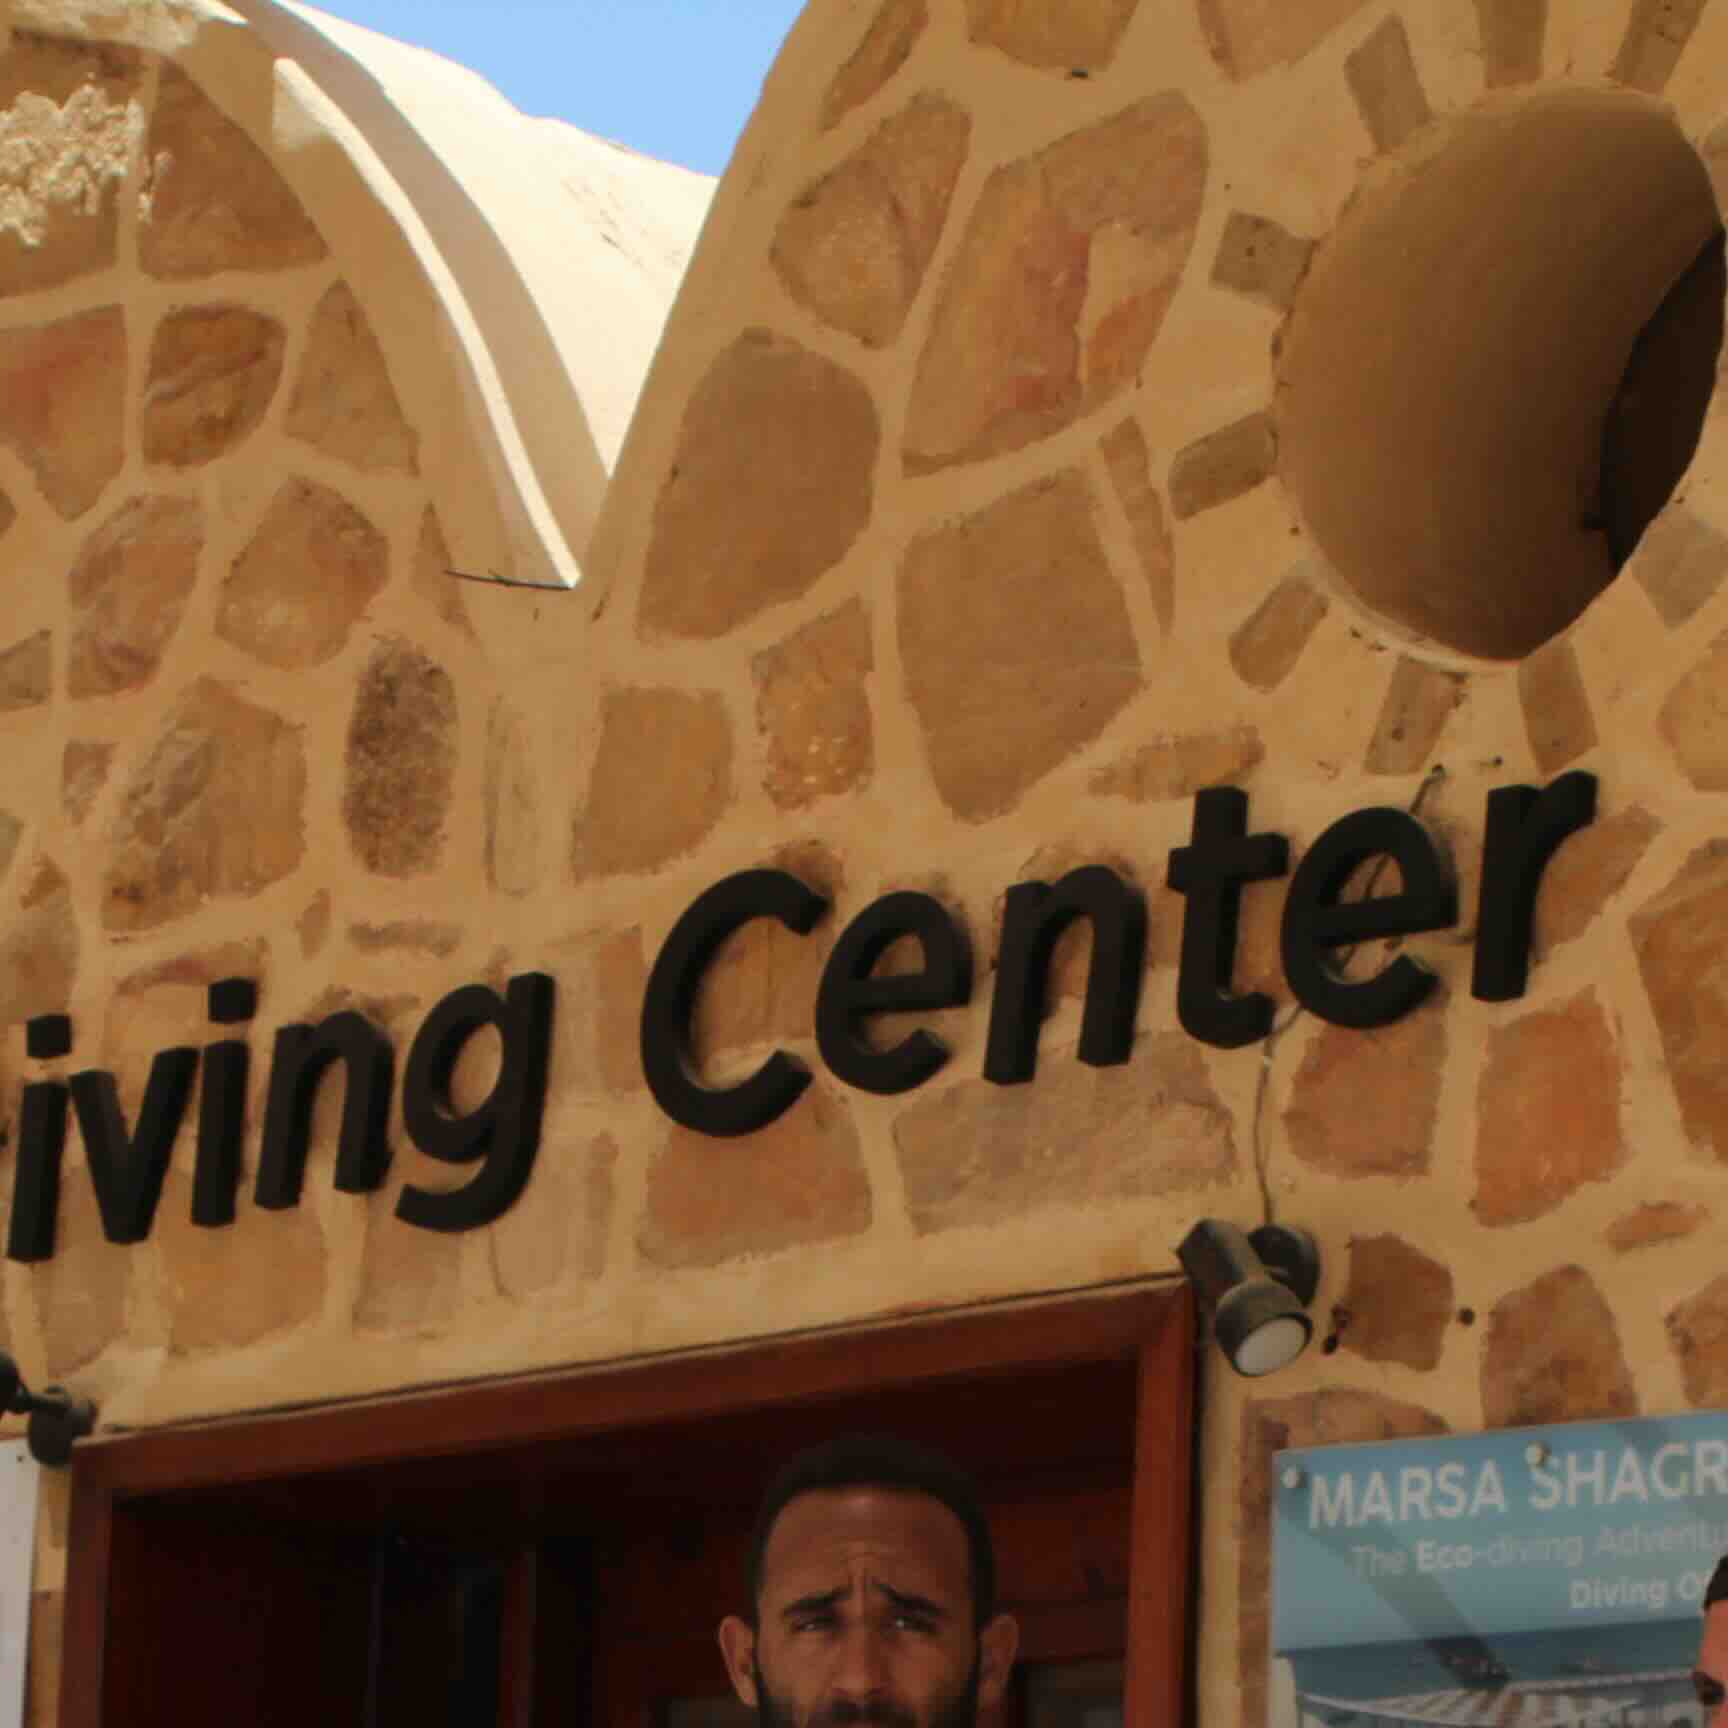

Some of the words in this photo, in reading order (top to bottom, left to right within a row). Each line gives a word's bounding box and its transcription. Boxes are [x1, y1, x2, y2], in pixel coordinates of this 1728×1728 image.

[640, 771, 1598, 1137] Center
[1309, 1460, 1507, 1530] MARSA
[1350, 1544, 1409, 1577] The
[1570, 1576, 1669, 1609] Diving
